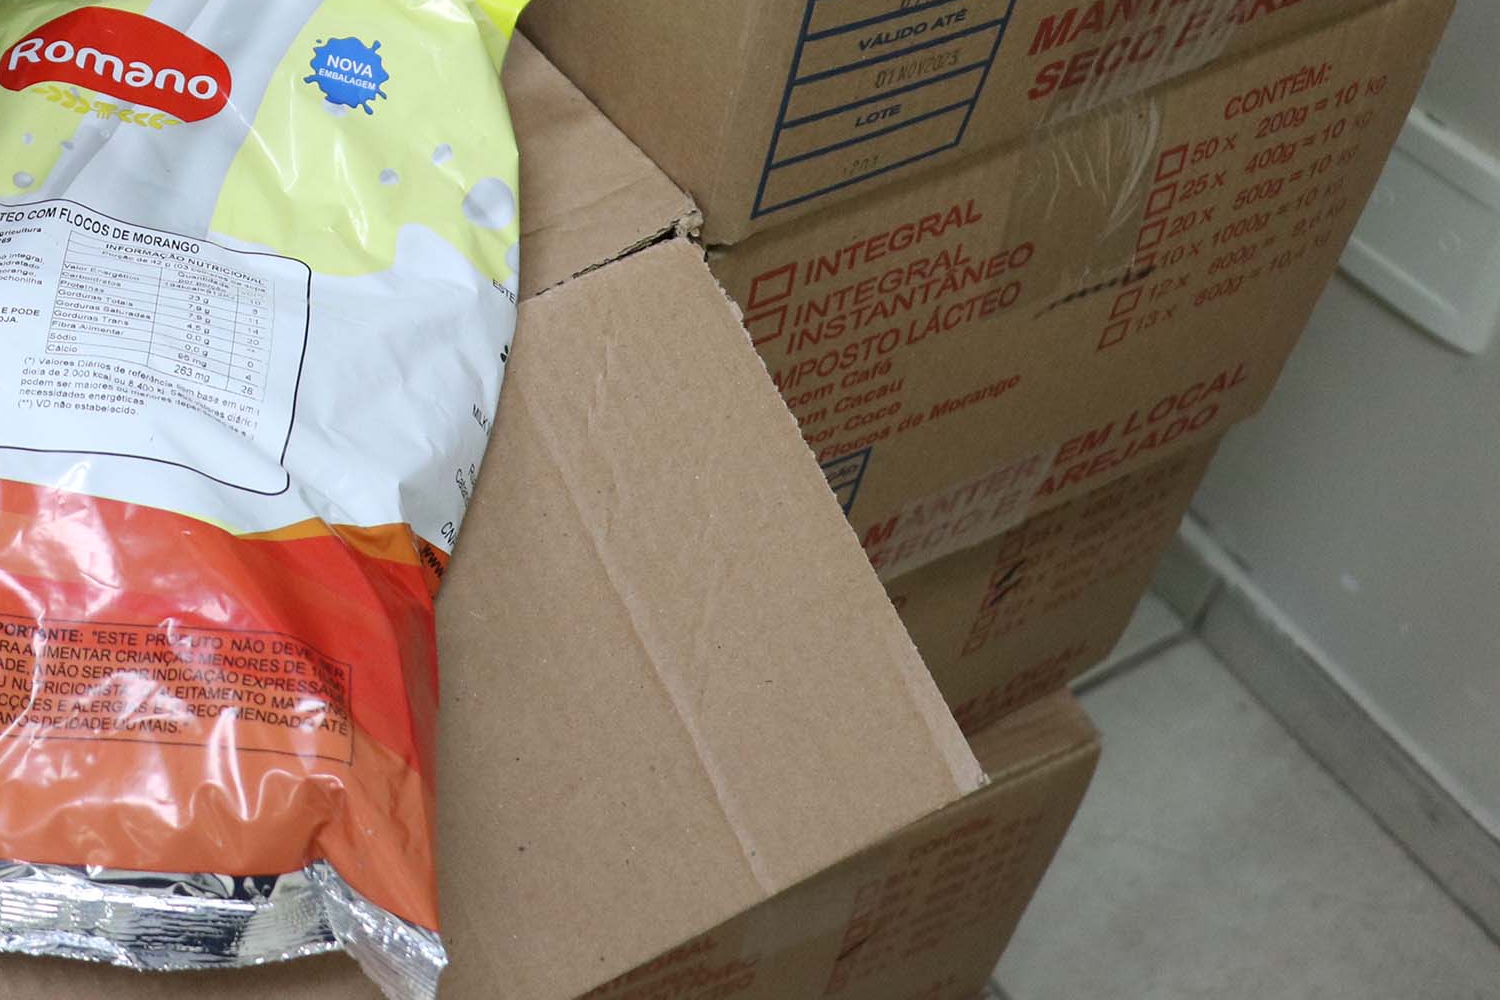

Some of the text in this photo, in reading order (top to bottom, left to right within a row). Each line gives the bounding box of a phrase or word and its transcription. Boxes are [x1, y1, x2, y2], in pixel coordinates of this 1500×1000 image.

[858, 8, 968, 51] VÁLIDO ATÉ
[7, 36, 219, 101] Romano
[318, 67, 377, 91] EMBALAGEM
[326, 52, 374, 78] NOVA
[1028, 23, 1164, 100] SECO
[1224, 62, 1332, 121] CONTÉM:
[855, 104, 901, 127] LOTE
[1190, 105, 1309, 164] 50 200g
[1182, 140, 1298, 202] 25 400g
[27, 206, 56, 221] COM
[59, 208, 110, 240] FLOCOS
[112, 223, 131, 241] DE
[132, 232, 200, 254] MORANGO
[804, 199, 982, 287] INTEGRAL
[1166, 212, 1196, 238] 20
[793, 243, 972, 327] INTEGRAL
[11, 307, 40, 316] PODE
[906, 280, 1022, 345] LÁCTEO
[834, 377, 904, 412] Cacau
[841, 359, 893, 387] Café
[844, 401, 901, 431] Coco
[930, 374, 1021, 420] Morango
[1052, 363, 1246, 465] EM LOCAL
[1036, 404, 1218, 496] AREJADO
[198, 654, 278, 673] MENORES
[284, 661, 306, 674] DE
[231, 637, 265, 652] NÃO
[45, 661, 78, 678] NÃO
[153, 665, 239, 684] INDICAÇÃO
